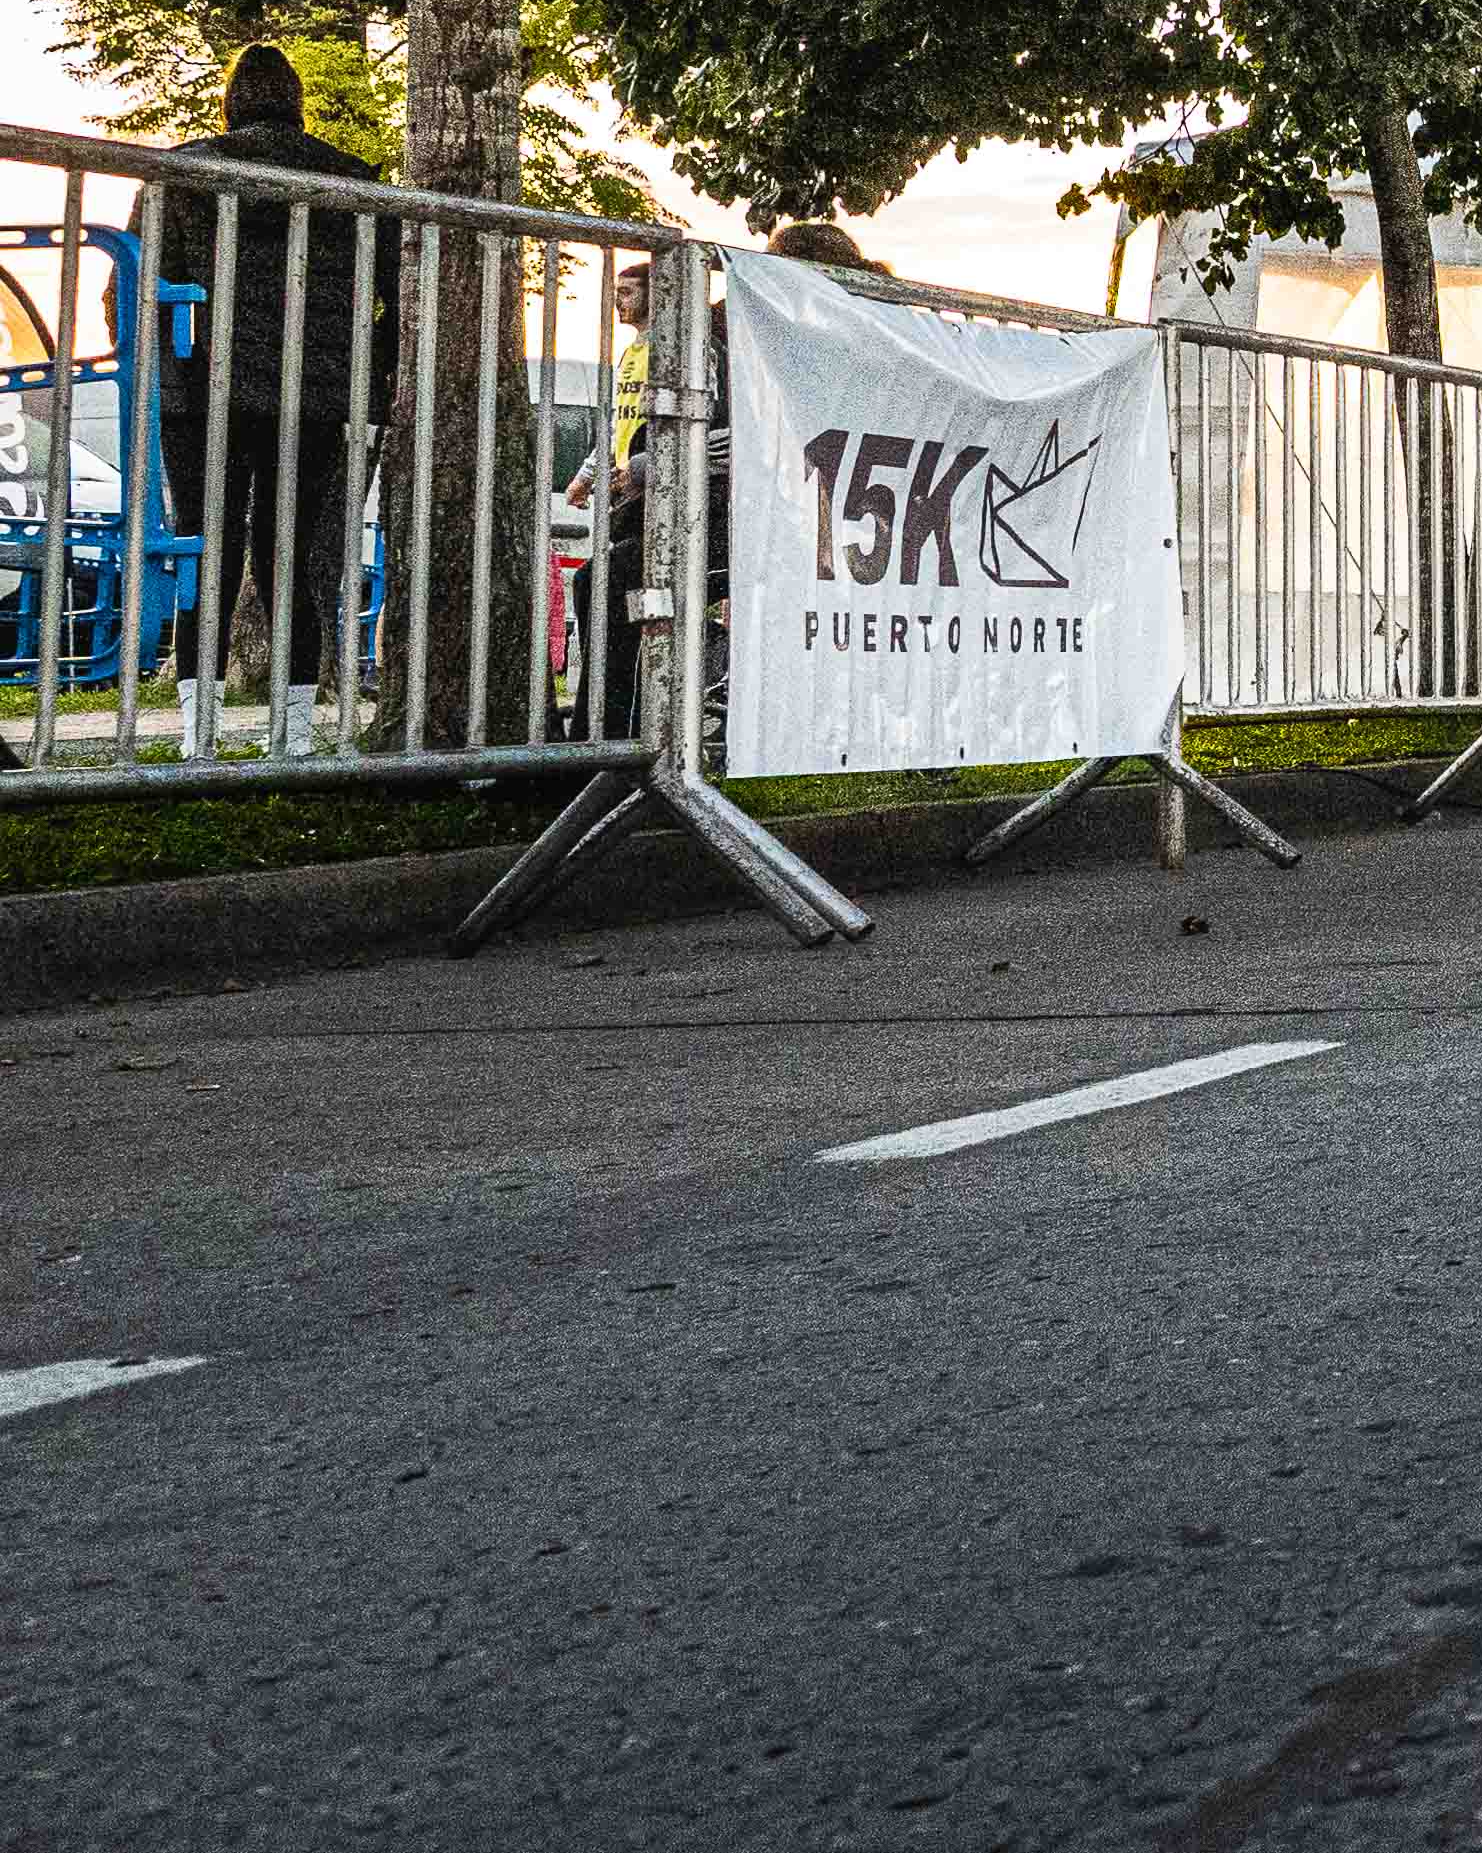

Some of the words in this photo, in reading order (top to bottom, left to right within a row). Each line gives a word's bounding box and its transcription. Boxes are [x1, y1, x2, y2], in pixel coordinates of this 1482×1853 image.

[804, 429, 989, 588] 15K
[805, 611, 961, 653] PUERTO
[984, 617, 1083, 654] NORTE
